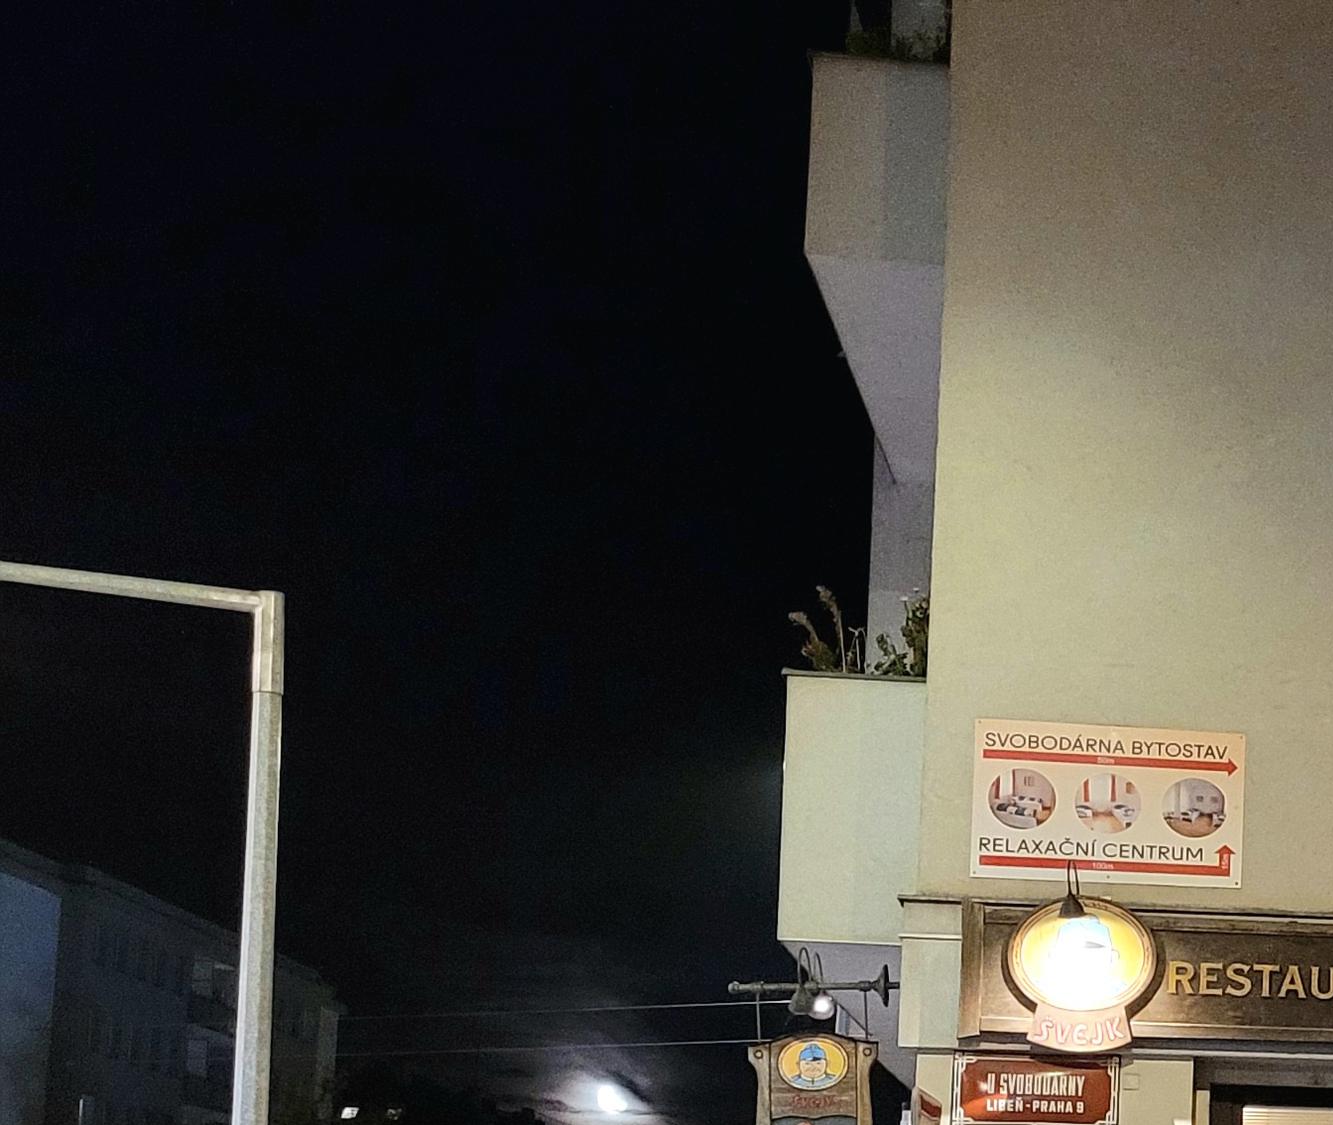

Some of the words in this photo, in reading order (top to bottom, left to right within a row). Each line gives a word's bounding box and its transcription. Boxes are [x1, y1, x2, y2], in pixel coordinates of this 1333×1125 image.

[984, 732, 1125, 755] SVOBODÁRNA
[1131, 740, 1229, 761] BYTOSTAV
[979, 837, 1097, 857] RELAXAČNÍ
[1102, 842, 1204, 862] CENTRUM
[1034, 1015, 1127, 1046] ŠVEJK
[986, 1072, 996, 1095] U
[986, 1097, 1024, 1113] LIBEŇ
[1032, 1100, 1073, 1113] PRAHA
[1076, 1100, 1085, 1113] 9
